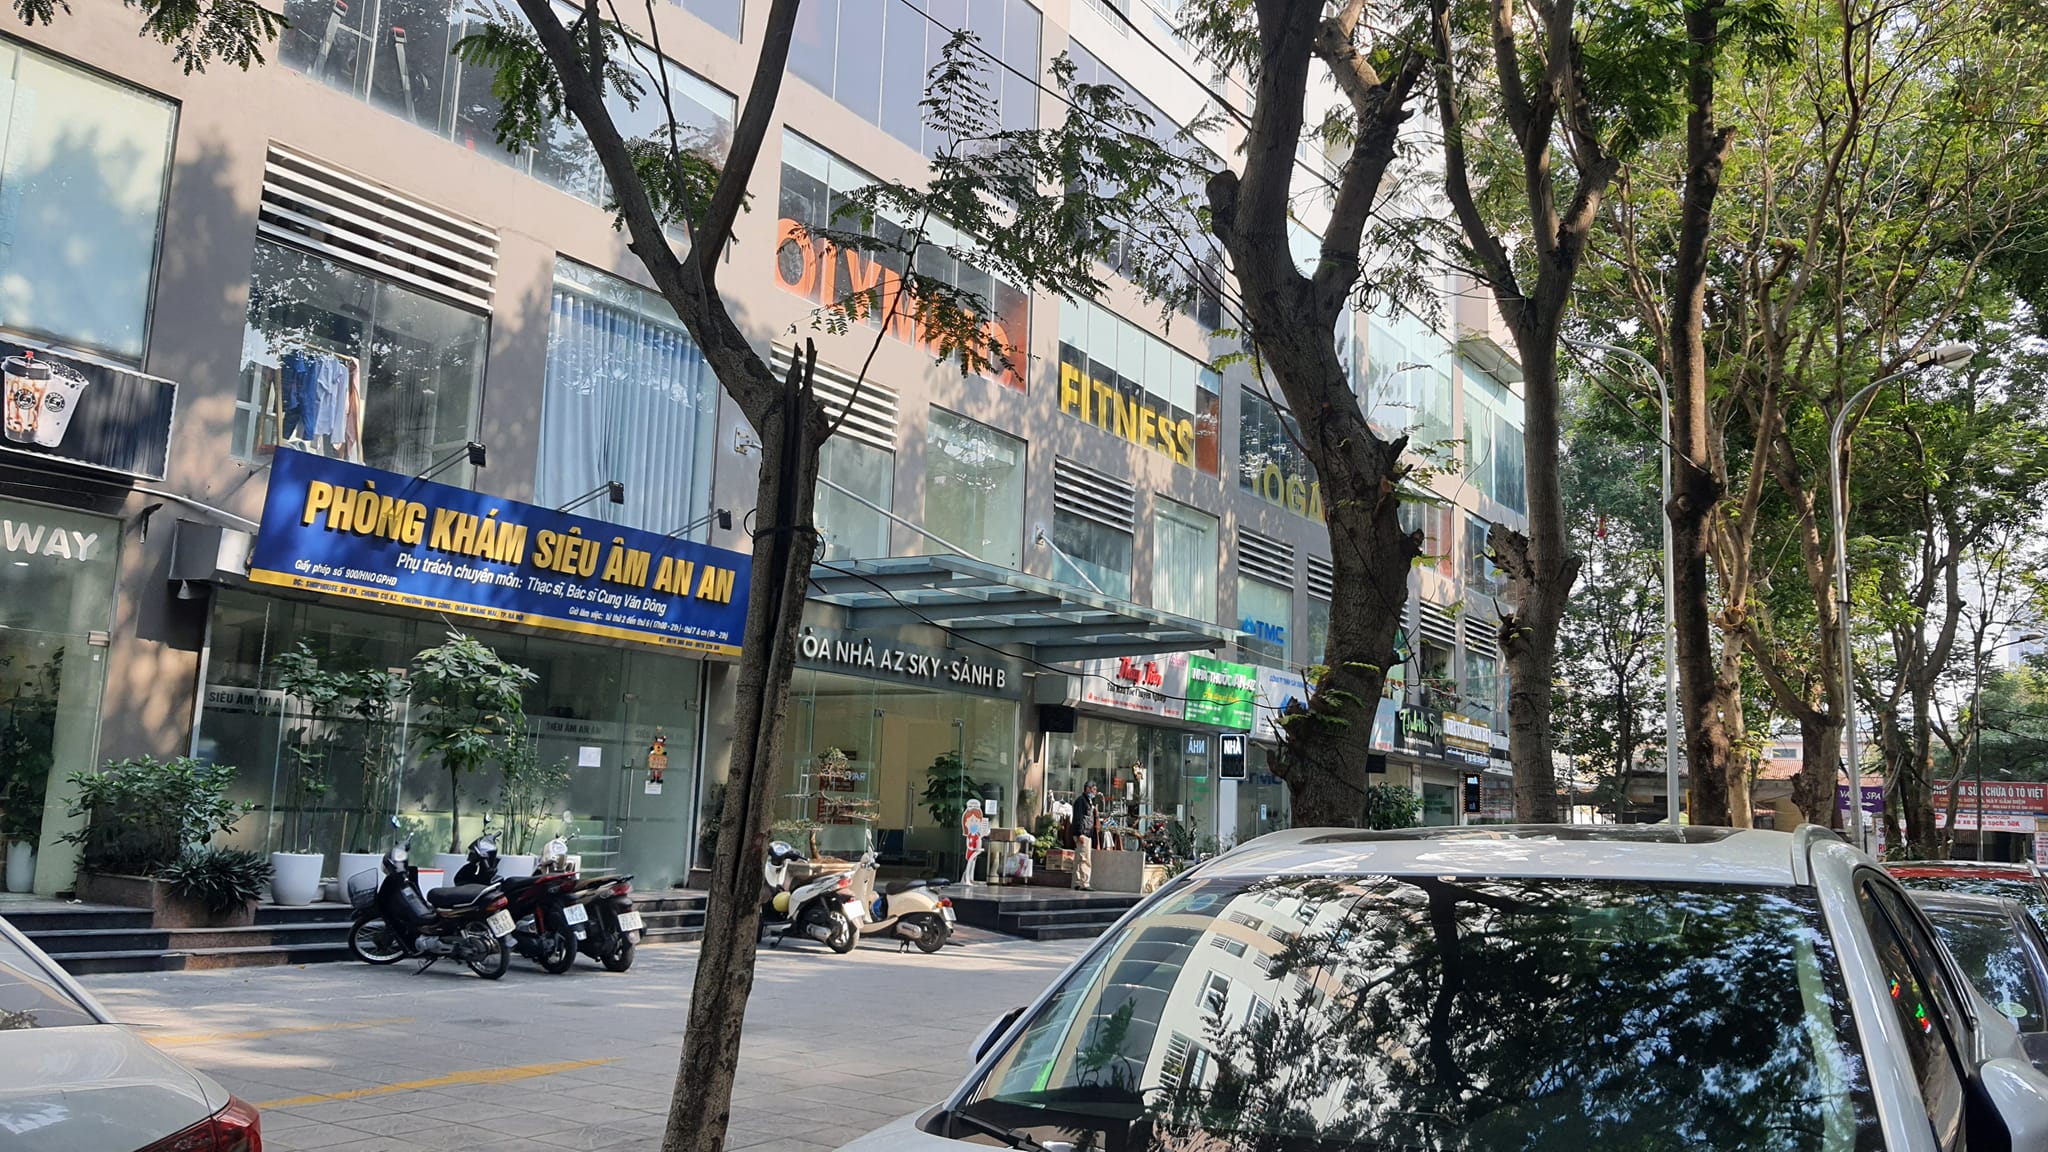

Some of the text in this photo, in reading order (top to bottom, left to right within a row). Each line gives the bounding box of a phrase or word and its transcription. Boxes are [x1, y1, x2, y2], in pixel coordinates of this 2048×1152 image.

[1059, 362, 1195, 468] FITNESS
[1251, 459, 1325, 526] YOGA
[3, 519, 99, 562] WAY
[303, 480, 736, 604] PHÒNG KHÁM SIÊU ÂM AN AN
[294, 559, 311, 573] Giấy
[332, 566, 345, 577] số
[396, 552, 668, 617] Phụ trách chuyên môn: Thạc sĩ, Bác sĩ Cung Văn Đông
[1256, 621, 1285, 644] TMC
[797, 626, 831, 660] ÒA
[836, 638, 875, 667] NHÀ
[880, 649, 905, 671] AZ
[909, 654, 942, 677] SKY
[951, 656, 992, 686] SẢNH
[996, 669, 1006, 688] B
[1192, 665, 1208, 682] NHÀ
[1208, 668, 1232, 686] THUỐC
[208, 691, 234, 703] SIÊU
[1223, 737, 1242, 755] NHÀ
[1866, 791, 1882, 800] SPA
[1985, 785, 2006, 797] CHỮA
[2008, 785, 2014, 797] Ô
[2015, 785, 2026, 798] TÔ
[2027, 786, 2044, 801] VIỆT
